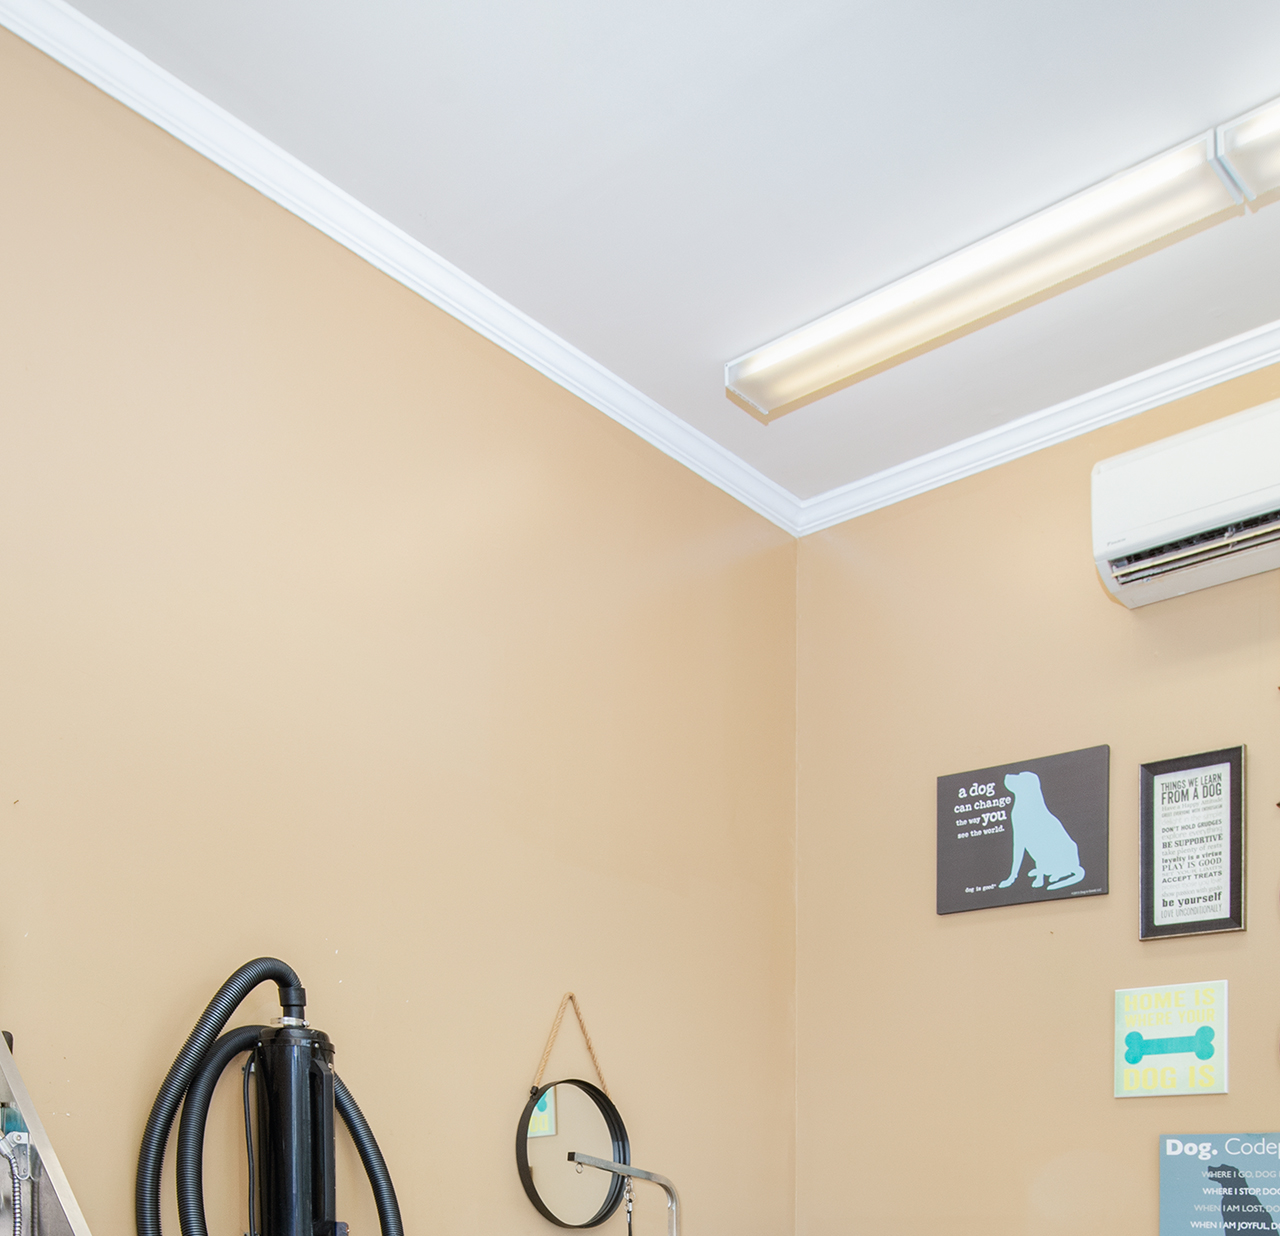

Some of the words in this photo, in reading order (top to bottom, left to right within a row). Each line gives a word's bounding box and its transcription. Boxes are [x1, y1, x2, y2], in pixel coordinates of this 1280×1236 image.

[958, 787, 967, 798] a
[969, 783, 995, 796] dog
[1161, 780, 1186, 792] THINGS
[1188, 777, 1199, 787] WE
[1201, 773, 1222, 785] LEARN
[1162, 789, 1189, 805] FROM
[1193, 788, 1199, 800] A
[1203, 783, 1222, 798] DOG
[954, 804, 972, 813] can
[974, 796, 1011, 810] change
[969, 816, 981, 825] way
[981, 810, 1007, 826] you
[1197, 819, 1222, 827] GRUDGES
[983, 825, 1005, 835] world.
[1162, 841, 1173, 849] BE
[1174, 833, 1223, 847] SUPPORTIVE
[1163, 863, 1183, 871] PLAY
[1199, 857, 1222, 866] GOOD
[1162, 875, 1191, 883] ACCEPT
[1194, 871, 1222, 879] TREATS
[1163, 899, 1174, 907] be
[1178, 891, 1222, 908] yourself
[1125, 991, 1186, 1011] HOME
[1195, 988, 1215, 1006] IS
[1125, 1012, 1172, 1027] WHERE
[1178, 1008, 1215, 1023] YOUR
[1124, 1067, 1176, 1090] DOG
[1189, 1065, 1215, 1087] IS
[1166, 1139, 1218, 1160] Dog.
[1239, 1188, 1261, 1196] STOP,
[1242, 1205, 1264, 1213] LOST,
[1190, 1221, 1218, 1229] WHEN
[1238, 1222, 1269, 1231] JOYFUL,
